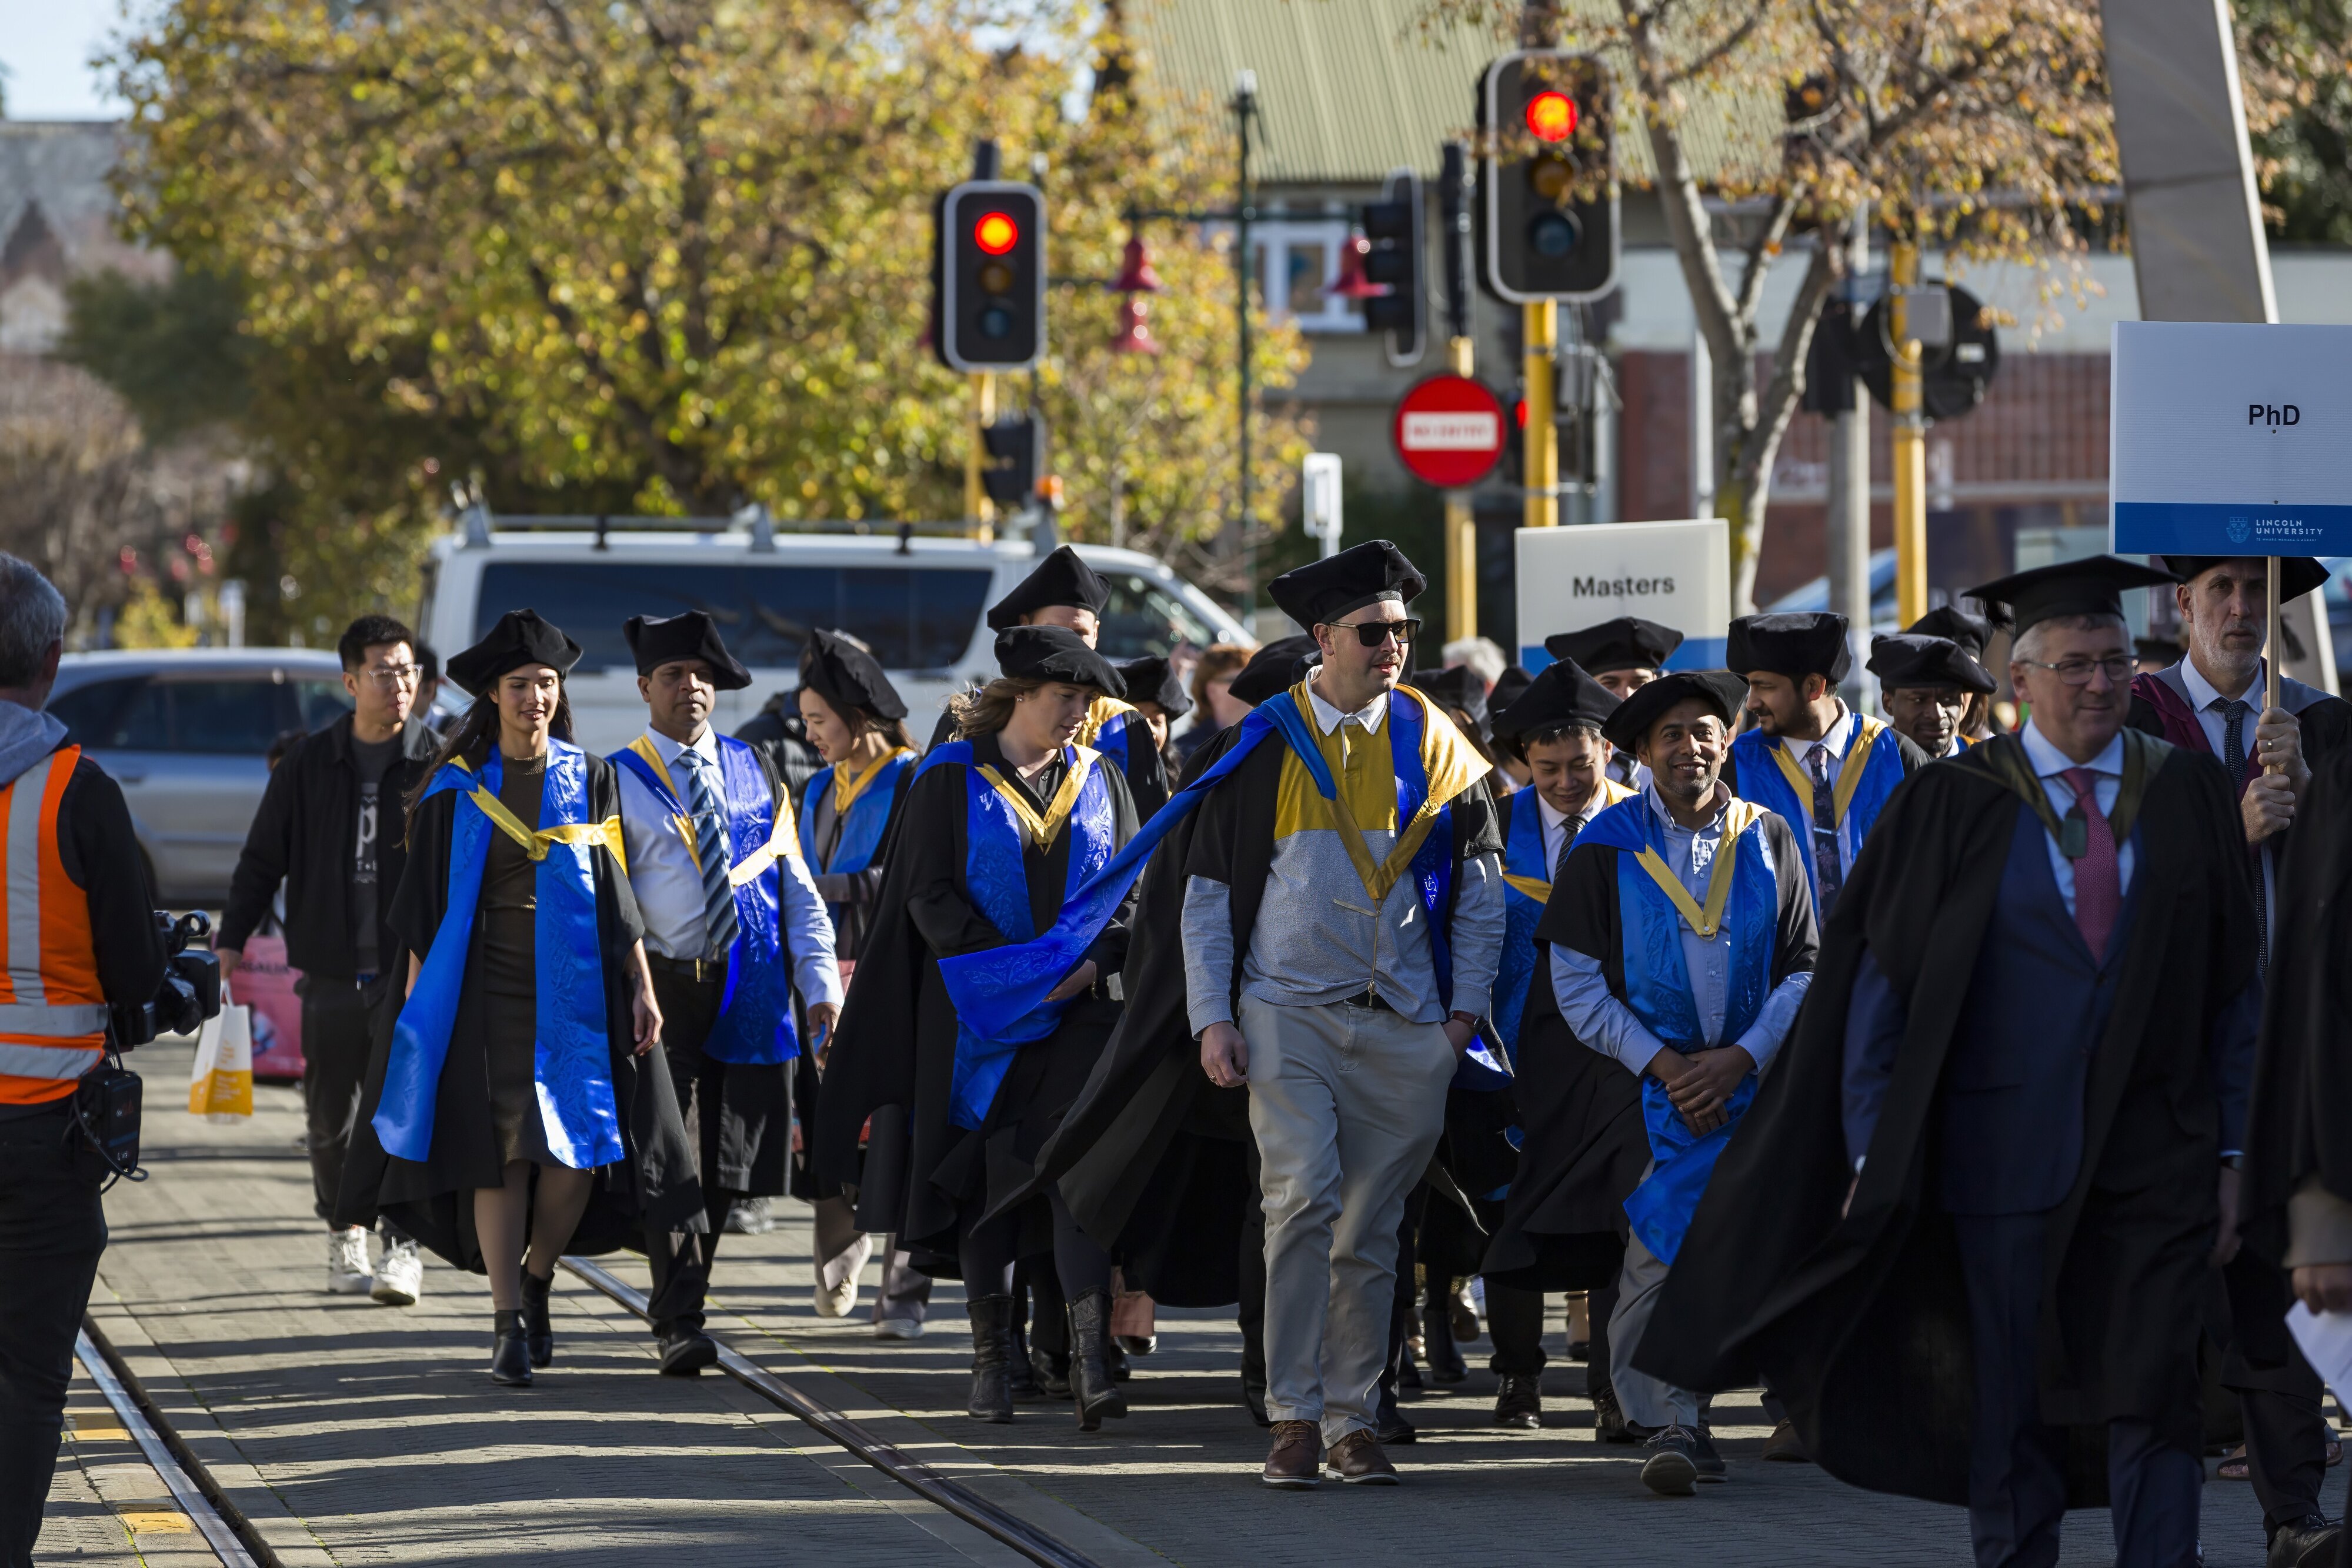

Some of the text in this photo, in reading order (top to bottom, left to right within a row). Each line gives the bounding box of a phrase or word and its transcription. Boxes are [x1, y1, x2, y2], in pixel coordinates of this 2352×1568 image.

[2249, 404, 2300, 426] PhD
[2256, 527, 2323, 535] UNIVERSITY
[1573, 576, 1675, 597] Masters
